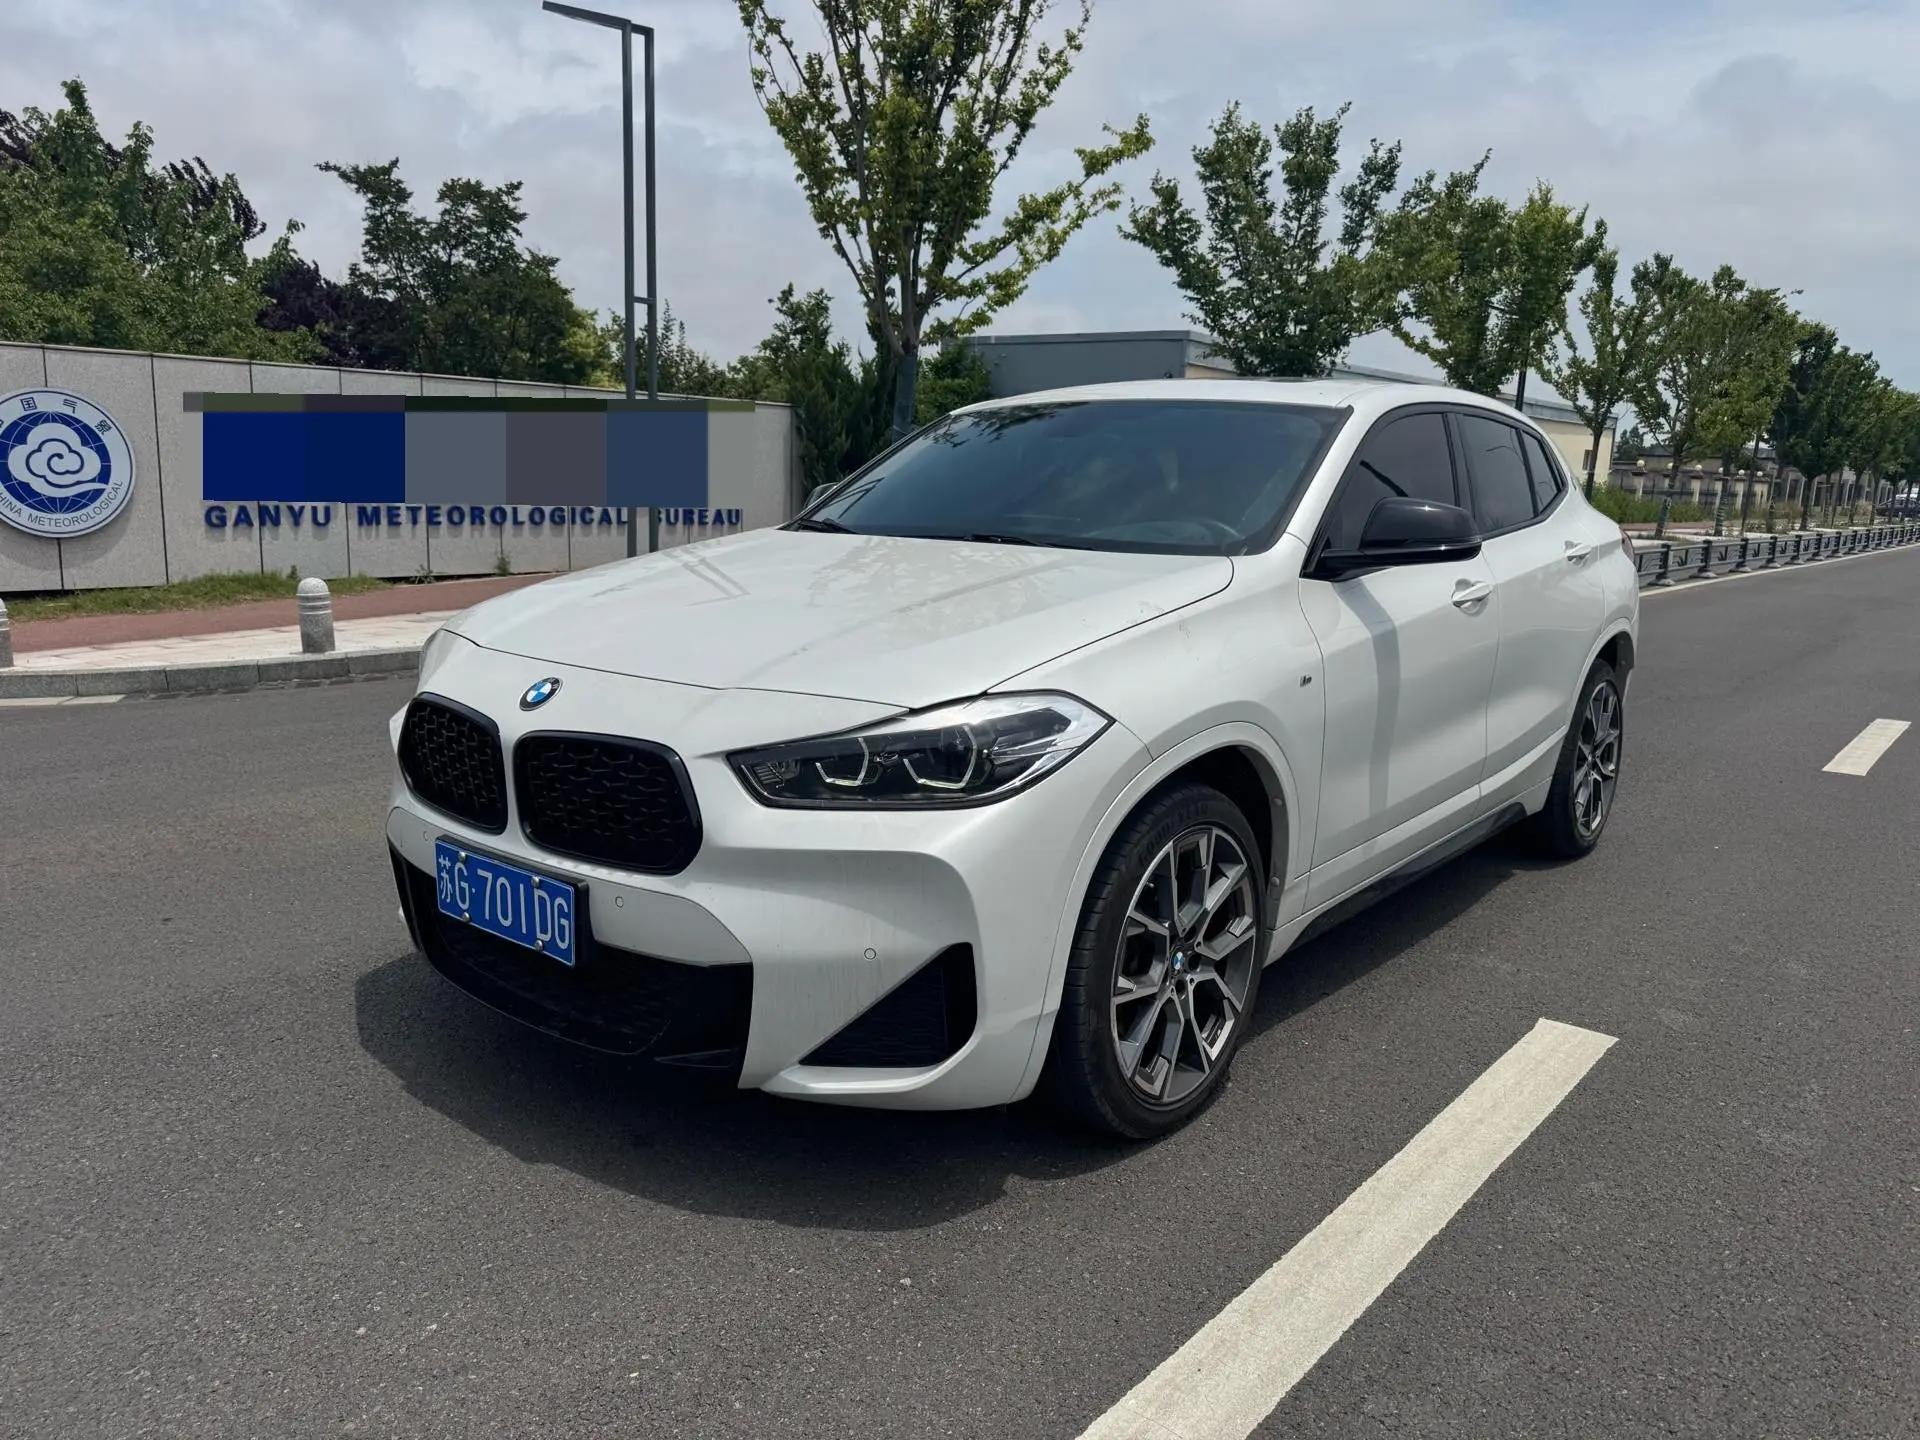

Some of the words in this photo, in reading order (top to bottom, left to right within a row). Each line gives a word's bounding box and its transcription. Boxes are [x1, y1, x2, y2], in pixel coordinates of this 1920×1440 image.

[0, 396, 112, 436] 国气象
[0, 491, 23, 518] HINA
[27, 479, 124, 528] METEOROLOGICAL
[204, 504, 332, 528] GANYU
[356, 505, 628, 527] METEOROLOGICAL
